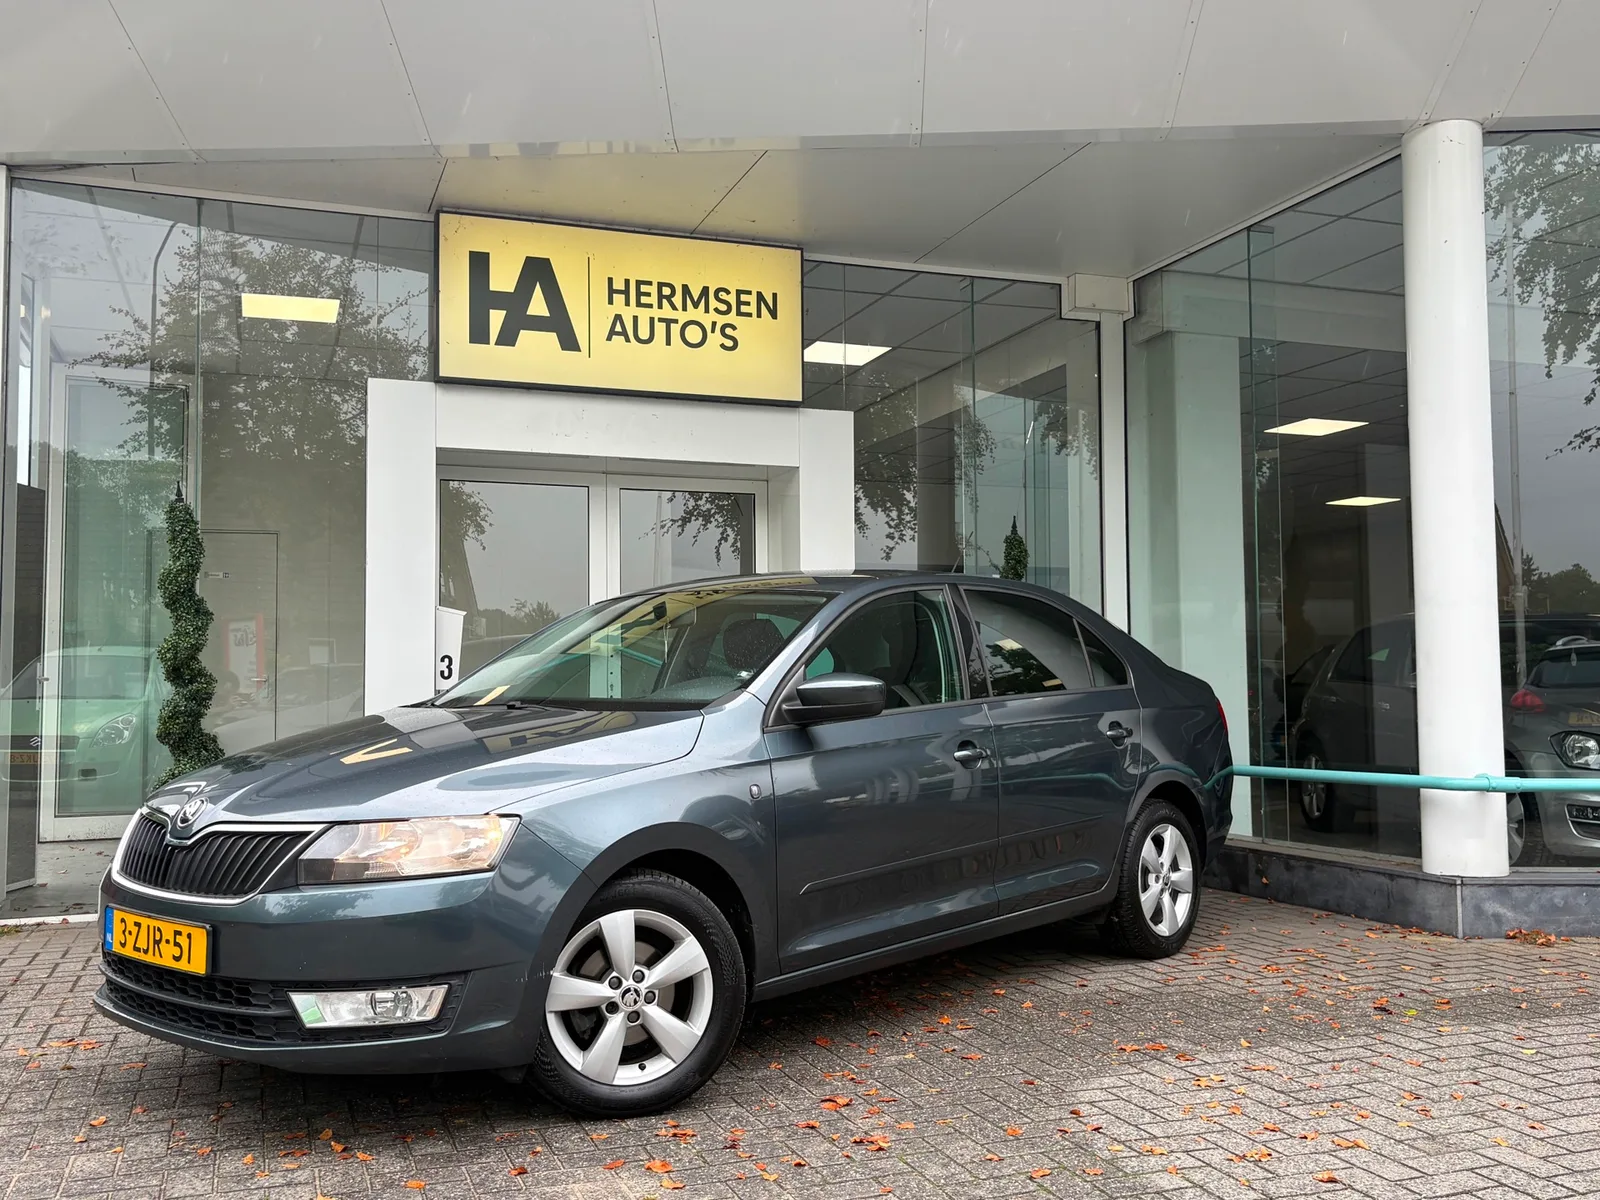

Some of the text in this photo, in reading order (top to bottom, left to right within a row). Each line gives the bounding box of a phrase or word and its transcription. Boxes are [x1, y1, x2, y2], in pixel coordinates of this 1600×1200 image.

[468, 250, 582, 353] HA
[606, 276, 779, 320] HERMSEN
[605, 313, 740, 352] AUTO'S
[439, 654, 453, 680] 3
[106, 917, 193, 965] NL 3-ZJR-51
